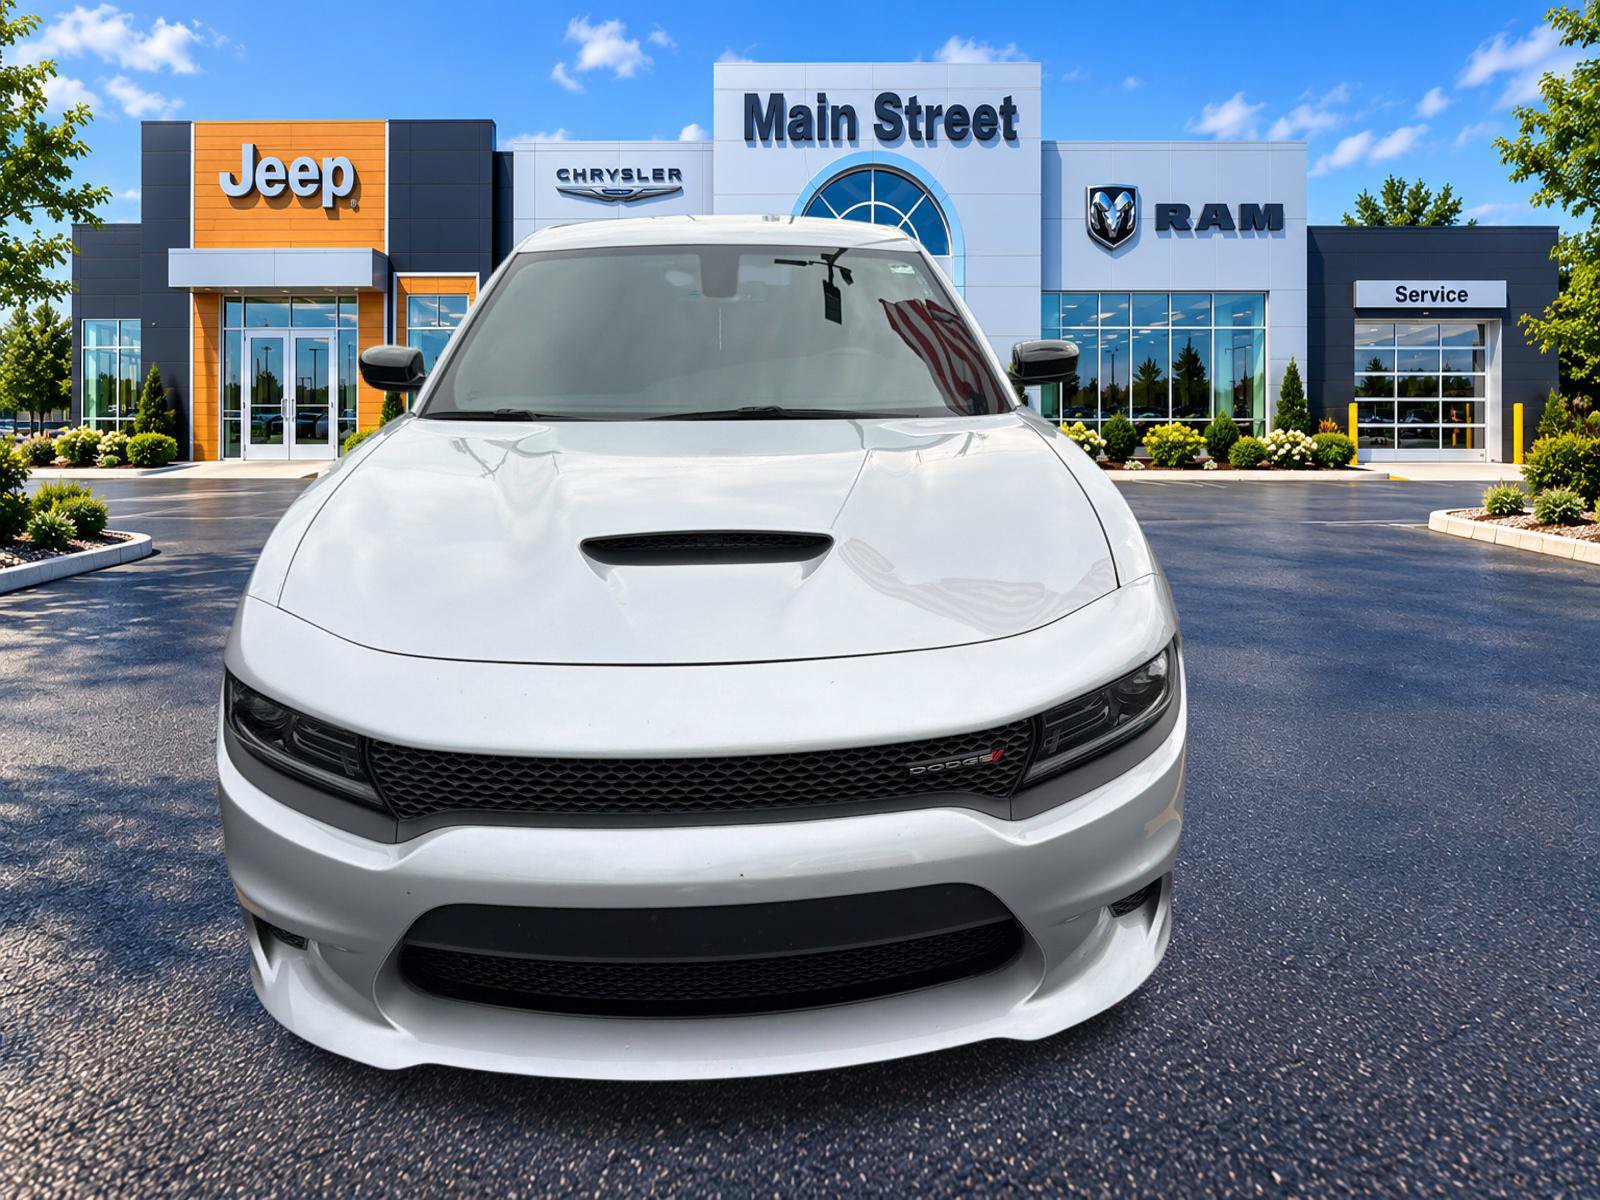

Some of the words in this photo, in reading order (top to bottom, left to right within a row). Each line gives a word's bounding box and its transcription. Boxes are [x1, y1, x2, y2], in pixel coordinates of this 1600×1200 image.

[744, 92, 857, 141] Main
[873, 91, 1018, 142] Street
[218, 143, 355, 209] Jeep
[556, 167, 683, 182] CHRYSLER
[1155, 203, 1284, 232] RAM
[1395, 285, 1469, 303] Service
[909, 753, 993, 774] DODGE
